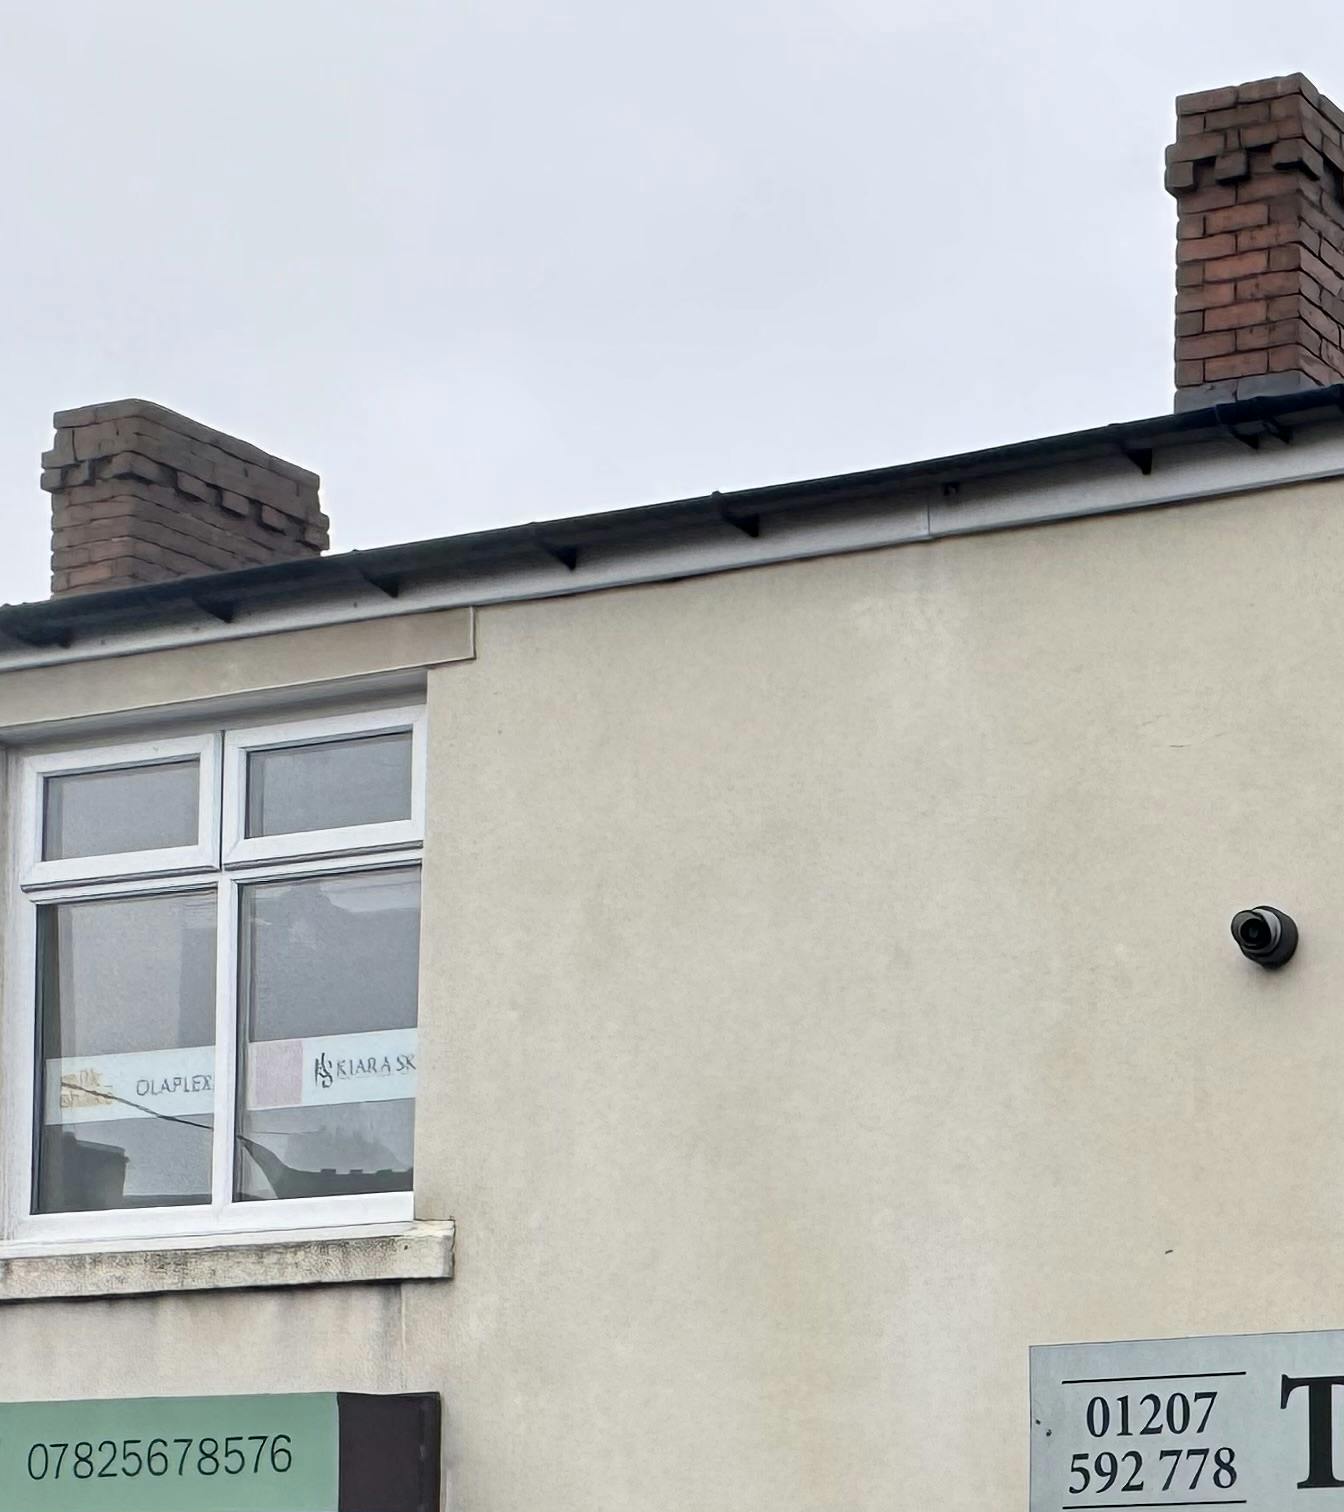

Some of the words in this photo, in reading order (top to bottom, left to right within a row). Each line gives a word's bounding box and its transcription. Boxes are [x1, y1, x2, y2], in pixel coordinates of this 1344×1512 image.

[136, 1074, 213, 1097] OLAPLEX
[336, 1055, 392, 1077] KIARA
[1085, 1391, 1219, 1438] 01207
[27, 1433, 293, 1481] 07825678576
[1067, 1450, 1145, 1495] 592
[1157, 1446, 1239, 1492] 778
